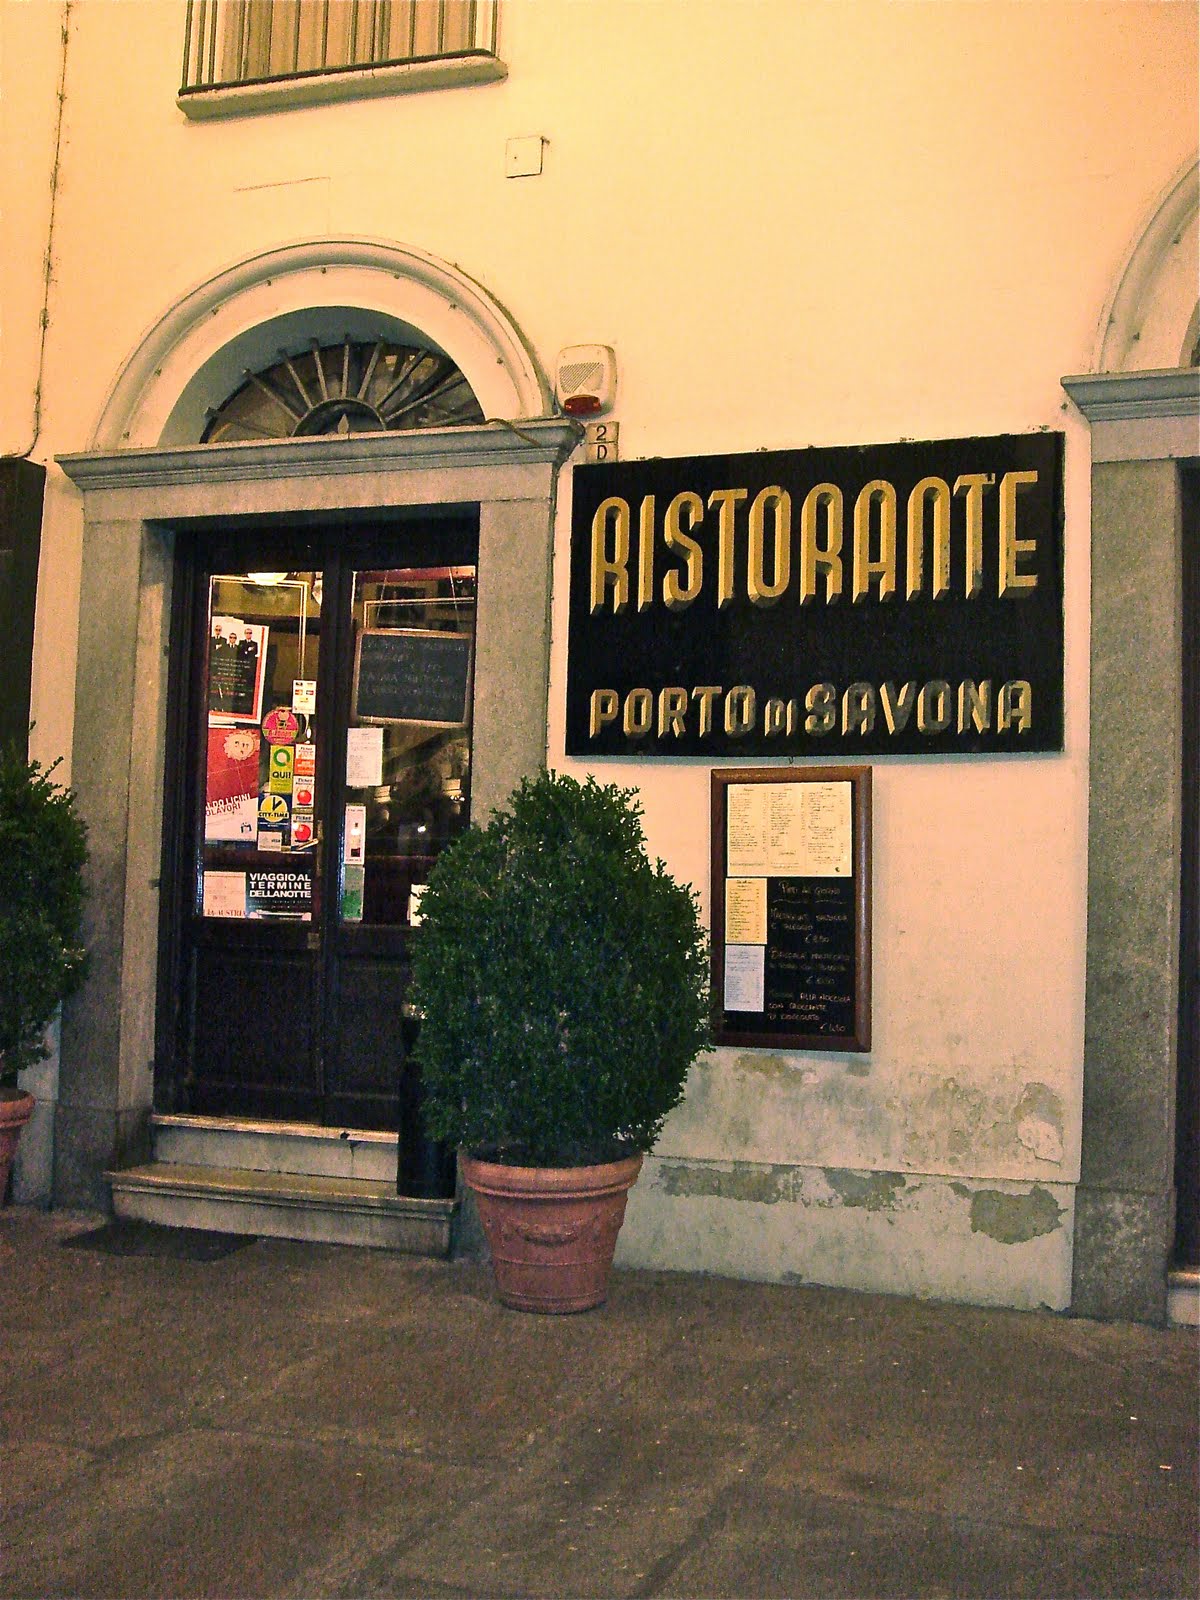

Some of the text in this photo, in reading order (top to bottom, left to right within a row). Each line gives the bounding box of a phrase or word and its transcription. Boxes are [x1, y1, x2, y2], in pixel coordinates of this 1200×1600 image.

[597, 425, 607, 441] 2
[597, 445, 607, 460] D
[590, 470, 1038, 614] RISTORANTE
[590, 684, 756, 738] PORTO
[804, 679, 1032, 736] SAVONA
[272, 771, 291, 779] QUI!
[249, 881, 312, 890] TERMINE
